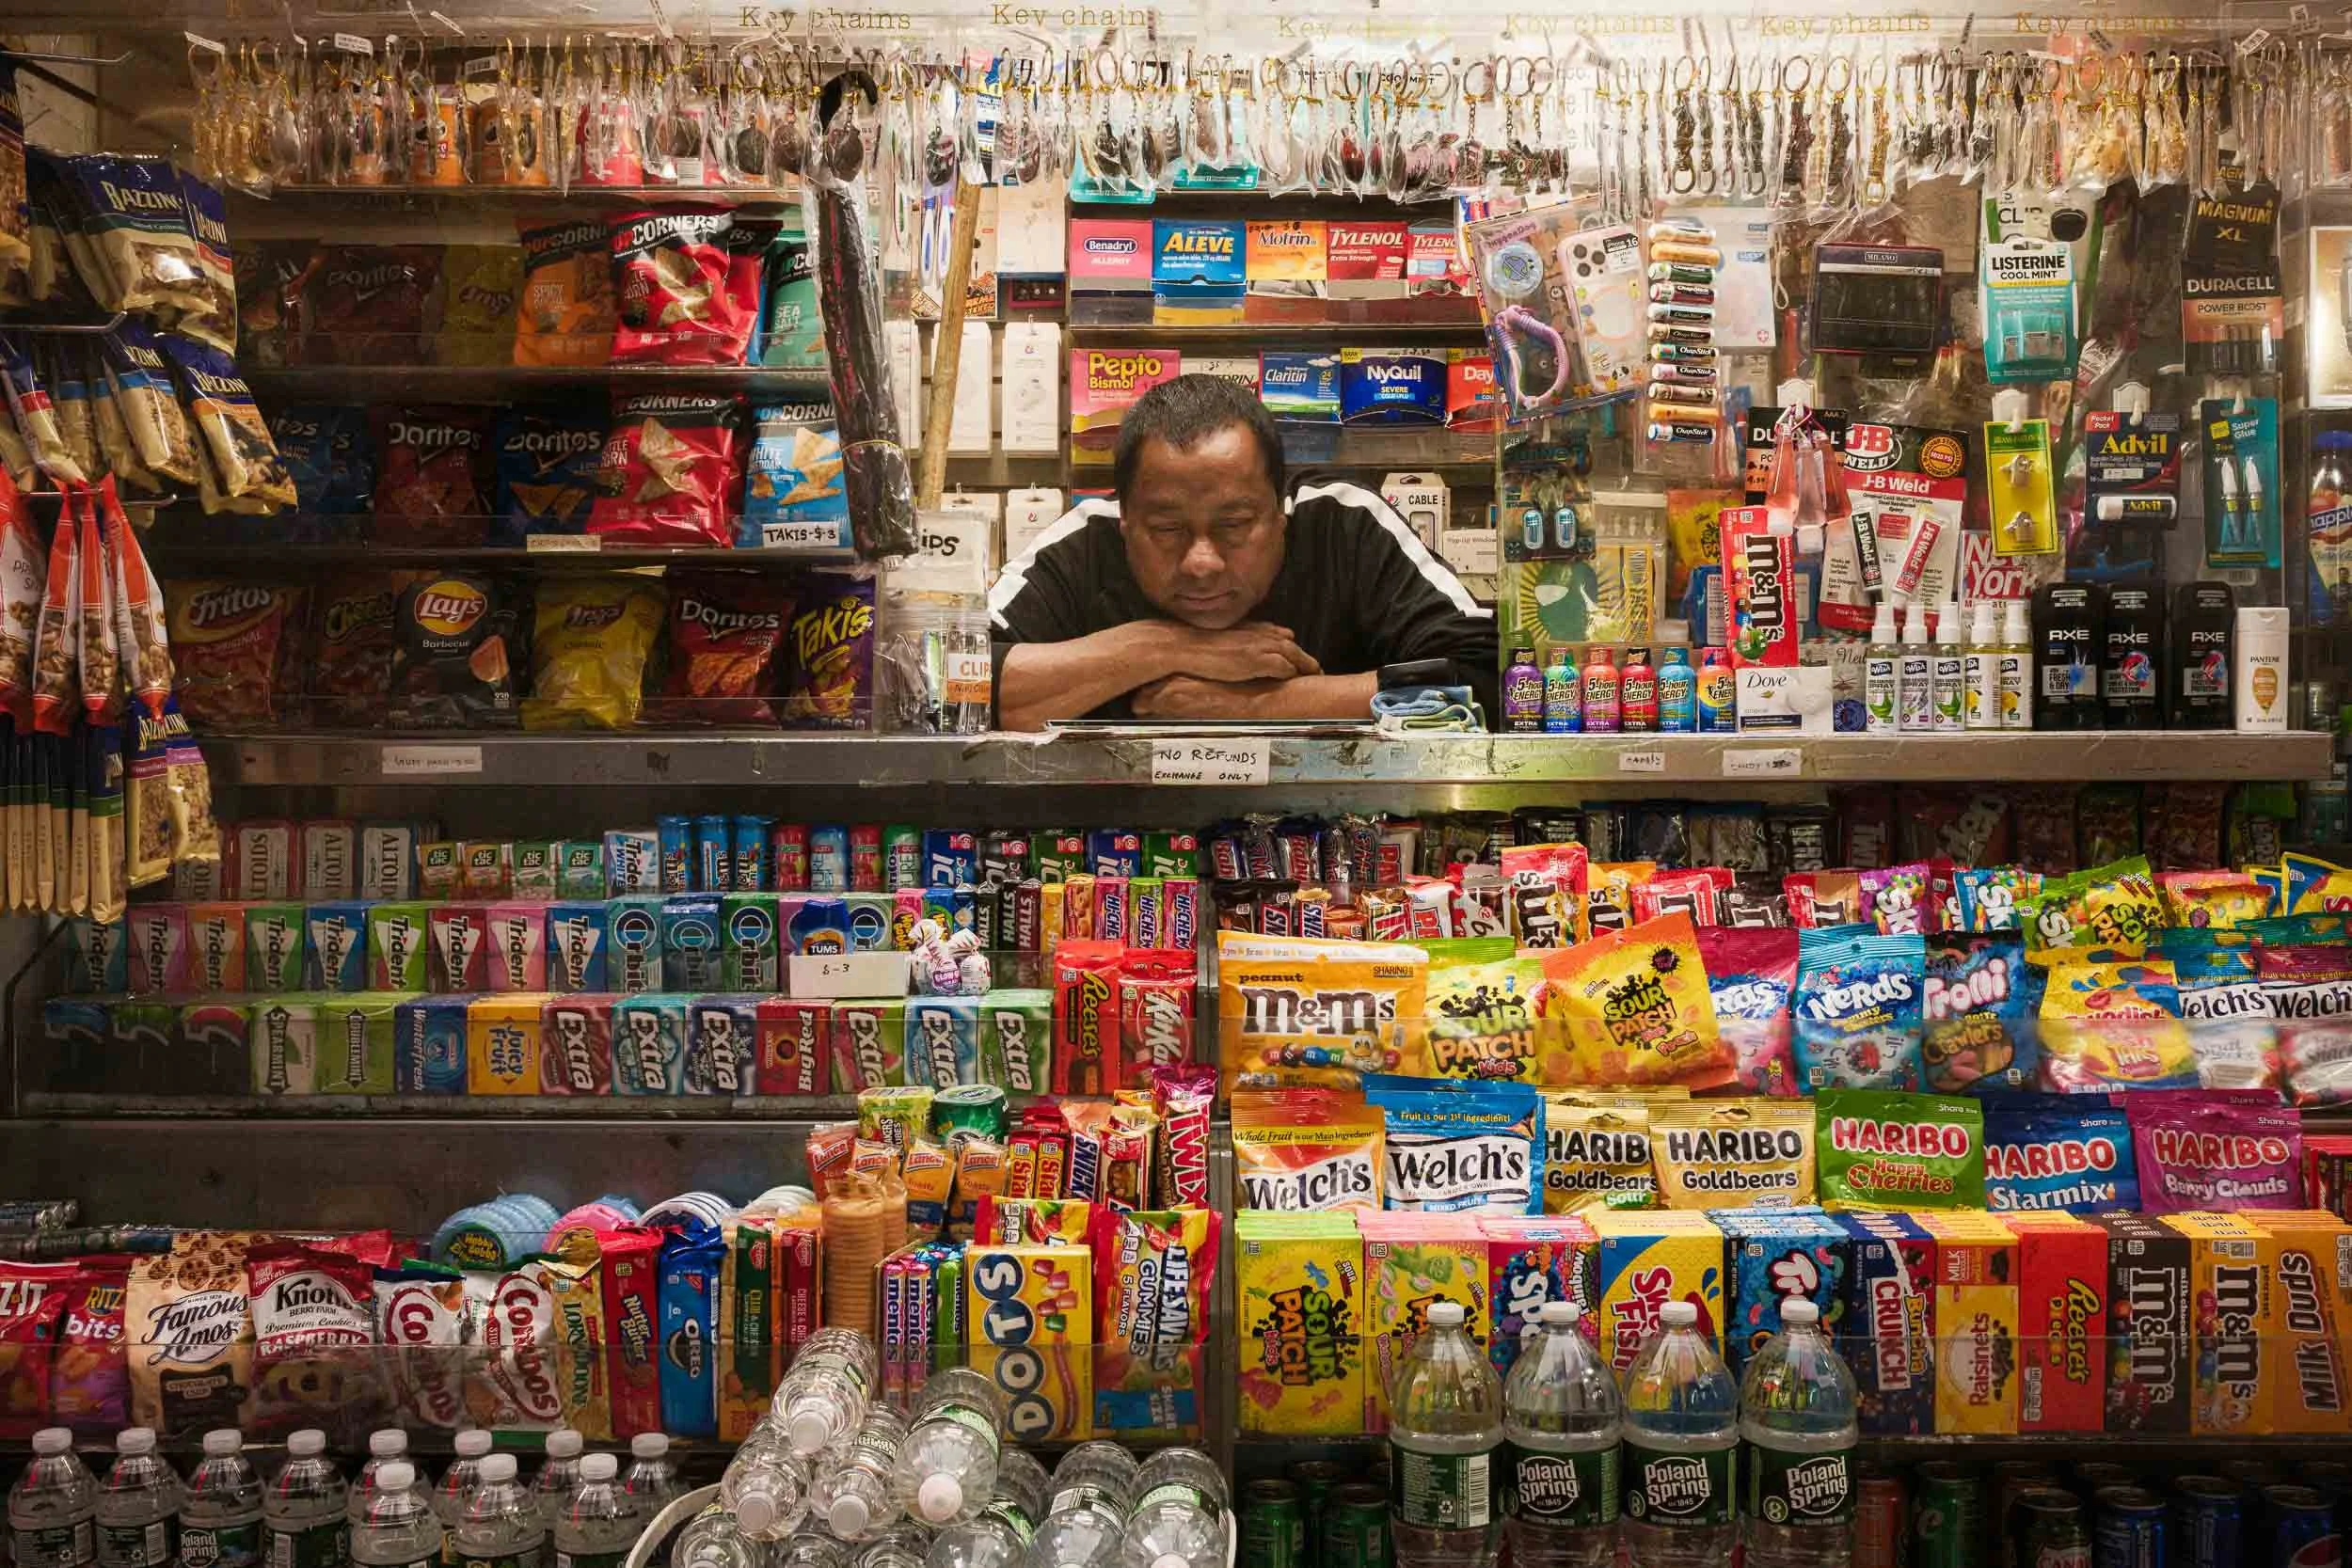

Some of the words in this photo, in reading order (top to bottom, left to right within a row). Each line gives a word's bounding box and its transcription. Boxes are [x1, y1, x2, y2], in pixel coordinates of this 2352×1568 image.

[2198, 198, 2273, 226] MAGNUM
[1089, 240, 1133, 253] Benadryl
[1165, 231, 1234, 254] ALEVE
[1258, 231, 1310, 247] Motrin
[1330, 230, 1404, 248] TYLENOL
[1626, 236, 1639, 248] 16
[2217, 227, 2246, 243] XL
[1992, 254, 2066, 272] LISTERINE
[2000, 271, 2030, 280] COOL
[2032, 270, 2058, 280] MINT
[2186, 277, 2275, 293] DURACELL
[2198, 302, 2233, 313] POWER
[1089, 353, 1162, 377] Pepto
[1264, 369, 1308, 384] Claritin
[1367, 365, 1422, 382] NyQuil
[1089, 377, 1135, 389] Bismol
[2099, 434, 2168, 454] Advil
[1889, 477, 1931, 493] Weld
[2129, 499, 2161, 512] Advil
[421, 593, 482, 622] Lay's
[682, 599, 780, 631] Doritos
[793, 599, 874, 654] Takis
[2049, 629, 2090, 641] AXE
[2108, 632, 2149, 643] AXE
[2192, 631, 2225, 642] AXE
[1747, 671, 1787, 688] Dove
[1586, 689, 1616, 702] ENERGY
[1160, 750, 1182, 763] NO
[1191, 748, 1257, 765] REFUNDS
[1218, 772, 1252, 783] ONLY
[1019, 895, 1034, 948] HALLS
[326, 916, 345, 990] Trident
[390, 916, 408, 990] Trident
[569, 916, 589, 990] Trident
[810, 944, 838, 955] TUMS
[1238, 973, 1304, 985] peanut
[1373, 966, 1408, 977] SHARING
[1082, 971, 1110, 1058] Reese's
[1241, 988, 1396, 1034] m&m's
[1604, 985, 1669, 1021] SOUR
[798, 1011, 816, 1052] Red
[1608, 998, 1677, 1041] PATCH
[411, 1006, 429, 1092] Winterfresh
[557, 1011, 596, 1090] Extra
[848, 1012, 886, 1090] Extra
[1432, 1034, 1539, 1065] PATCH
[798, 1053, 815, 1092] Big
[1938, 1103, 1964, 1113] Share
[2080, 1117, 2107, 1128] Share
[1668, 1130, 1804, 1164] HARIBO
[1833, 1118, 1969, 1157] HARIBO
[2153, 1130, 2290, 1168] HARIBO
[908, 1152, 945, 1169] Lance
[962, 1153, 998, 1167] Lance
[1167, 1106, 1211, 1208] TWIX
[1389, 1144, 1523, 1190] Welch's
[1874, 1159, 1925, 1178] Happy
[1246, 1156, 1371, 1212] Welch's
[1548, 1169, 1659, 1191] Goldbears
[1682, 1170, 1798, 1191] Goldbears
[1848, 1164, 1954, 1194] Cherries
[2166, 1176, 2216, 1199] Berry
[1992, 1180, 2109, 1212] Starmix
[1951, 1250, 1962, 1278] MILK
[87, 1287, 125, 1310] RITZ
[2279, 1252, 2324, 1334] Duds
[142, 1292, 250, 1344] Famous
[289, 1305, 314, 1316] BERRY
[623, 1293, 649, 1347] Nutter
[887, 1277, 900, 1364] mentos
[1117, 1285, 1133, 1338] FLAVORS
[1132, 1259, 1157, 1356] GUMMIES
[66, 1314, 121, 1338] bits
[1279, 1288, 1309, 1386] PATCH
[1304, 1292, 1336, 1380] SOUR
[1874, 1279, 1908, 1386] CRUNCH
[1904, 1296, 1928, 1373] Buncha
[2067, 1278, 2102, 1386] Reese's
[2130, 1267, 2176, 1404] m&m's
[2214, 1264, 2259, 1399] m&m's
[147, 1326, 234, 1369] Amos
[260, 1331, 362, 1357] RASPBERRY
[684, 1318, 702, 1379] OREO
[1970, 1312, 1990, 1407] Raisinets
[2296, 1339, 2341, 1412] Milk
[1518, 1456, 1575, 1483] Poland
[1645, 1456, 1708, 1484] Poland
[1787, 1457, 1847, 1488] Poland
[1518, 1478, 1579, 1502] Spring
[1647, 1477, 1710, 1505] Spring
[1788, 1478, 1849, 1509] Spring
